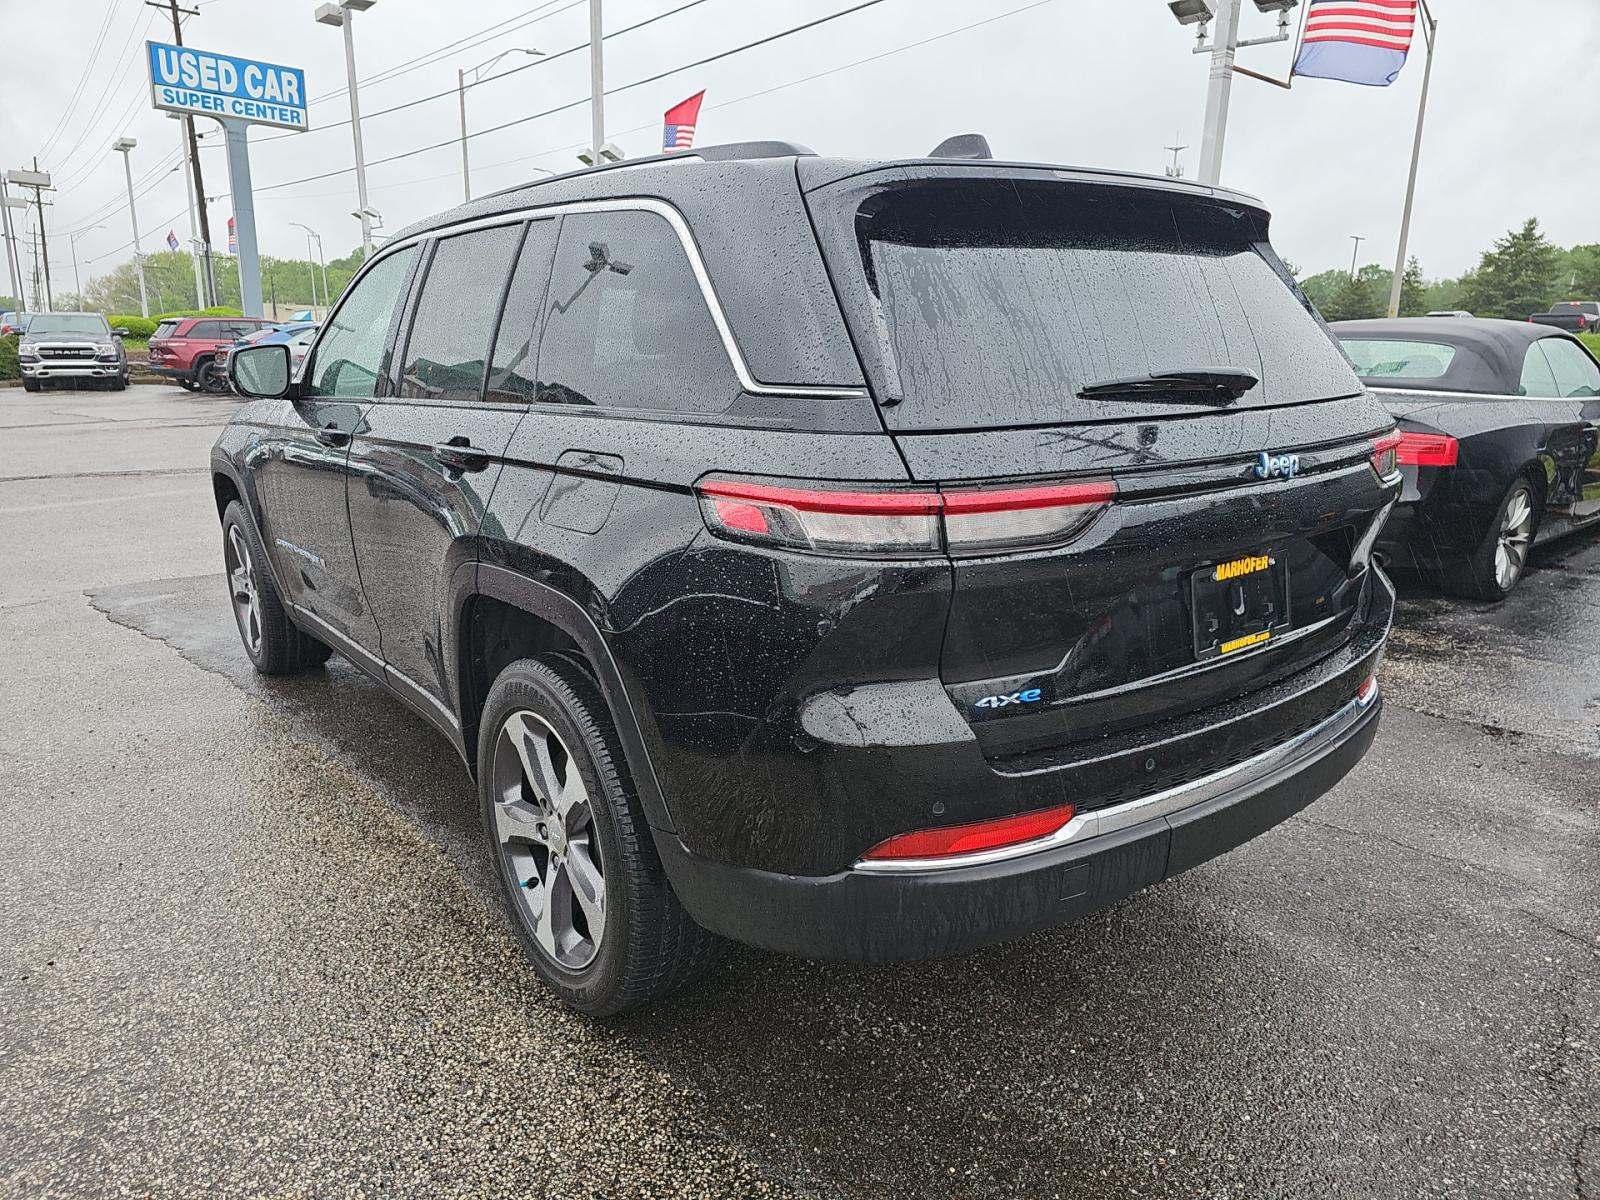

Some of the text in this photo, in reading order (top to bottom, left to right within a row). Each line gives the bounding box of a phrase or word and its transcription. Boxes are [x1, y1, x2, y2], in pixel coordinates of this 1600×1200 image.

[158, 48, 300, 105] USED CAR
[163, 88, 301, 123] SUPER CENTER
[1254, 452, 1299, 479] Jeep
[1216, 555, 1269, 581] MARHOFER
